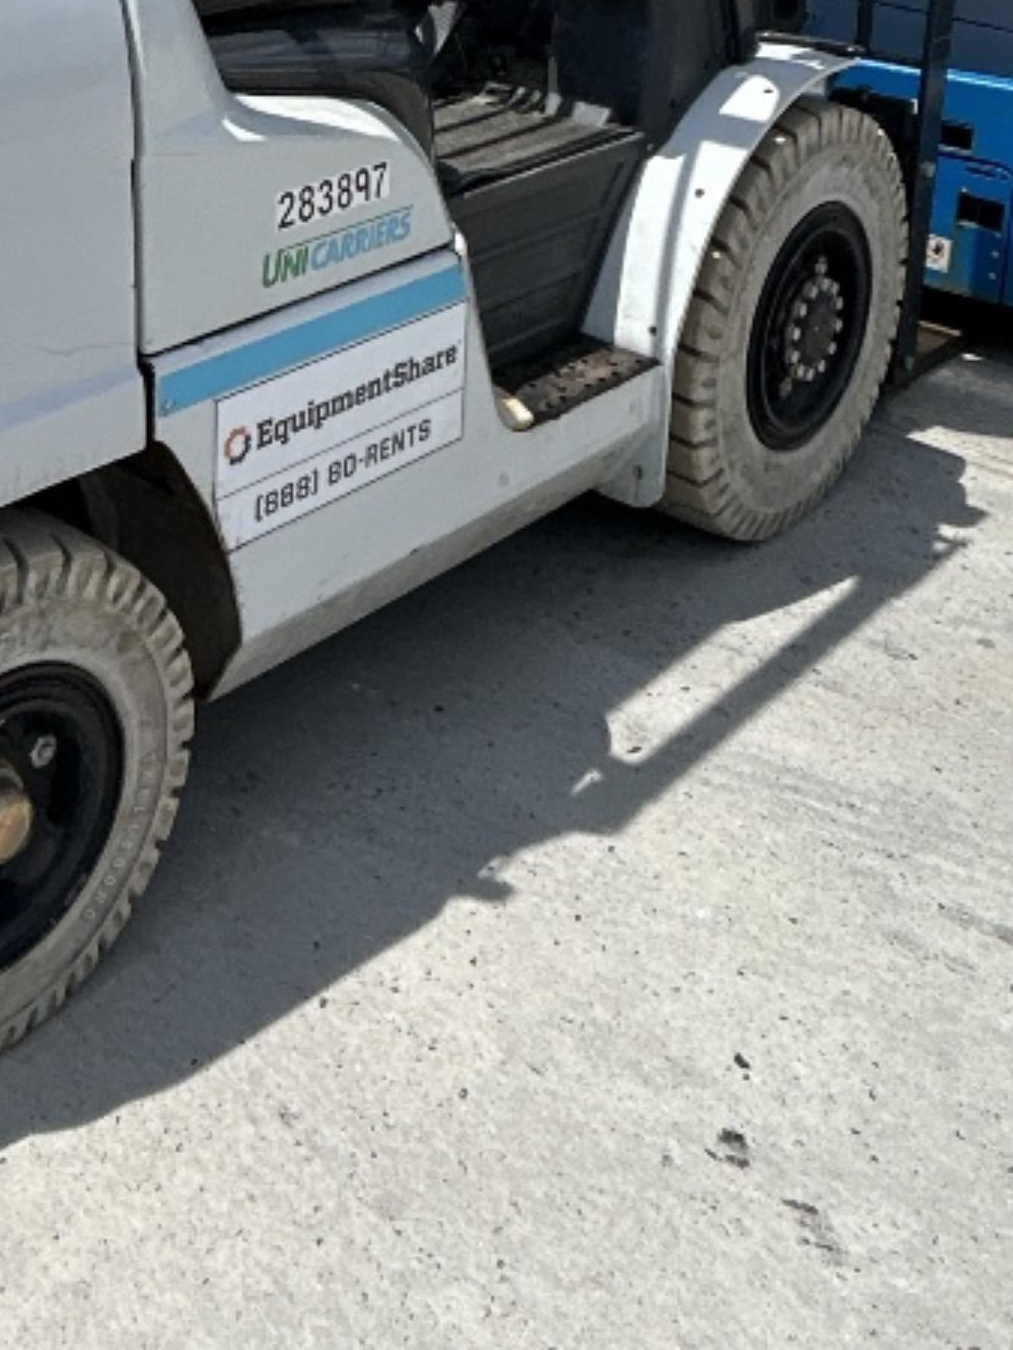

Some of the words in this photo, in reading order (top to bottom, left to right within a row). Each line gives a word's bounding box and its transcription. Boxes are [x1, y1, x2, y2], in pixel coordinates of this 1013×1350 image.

[277, 161, 388, 231] 283897
[261, 211, 413, 289] UNICARRIERS
[255, 344, 459, 451] EquipmentShare
